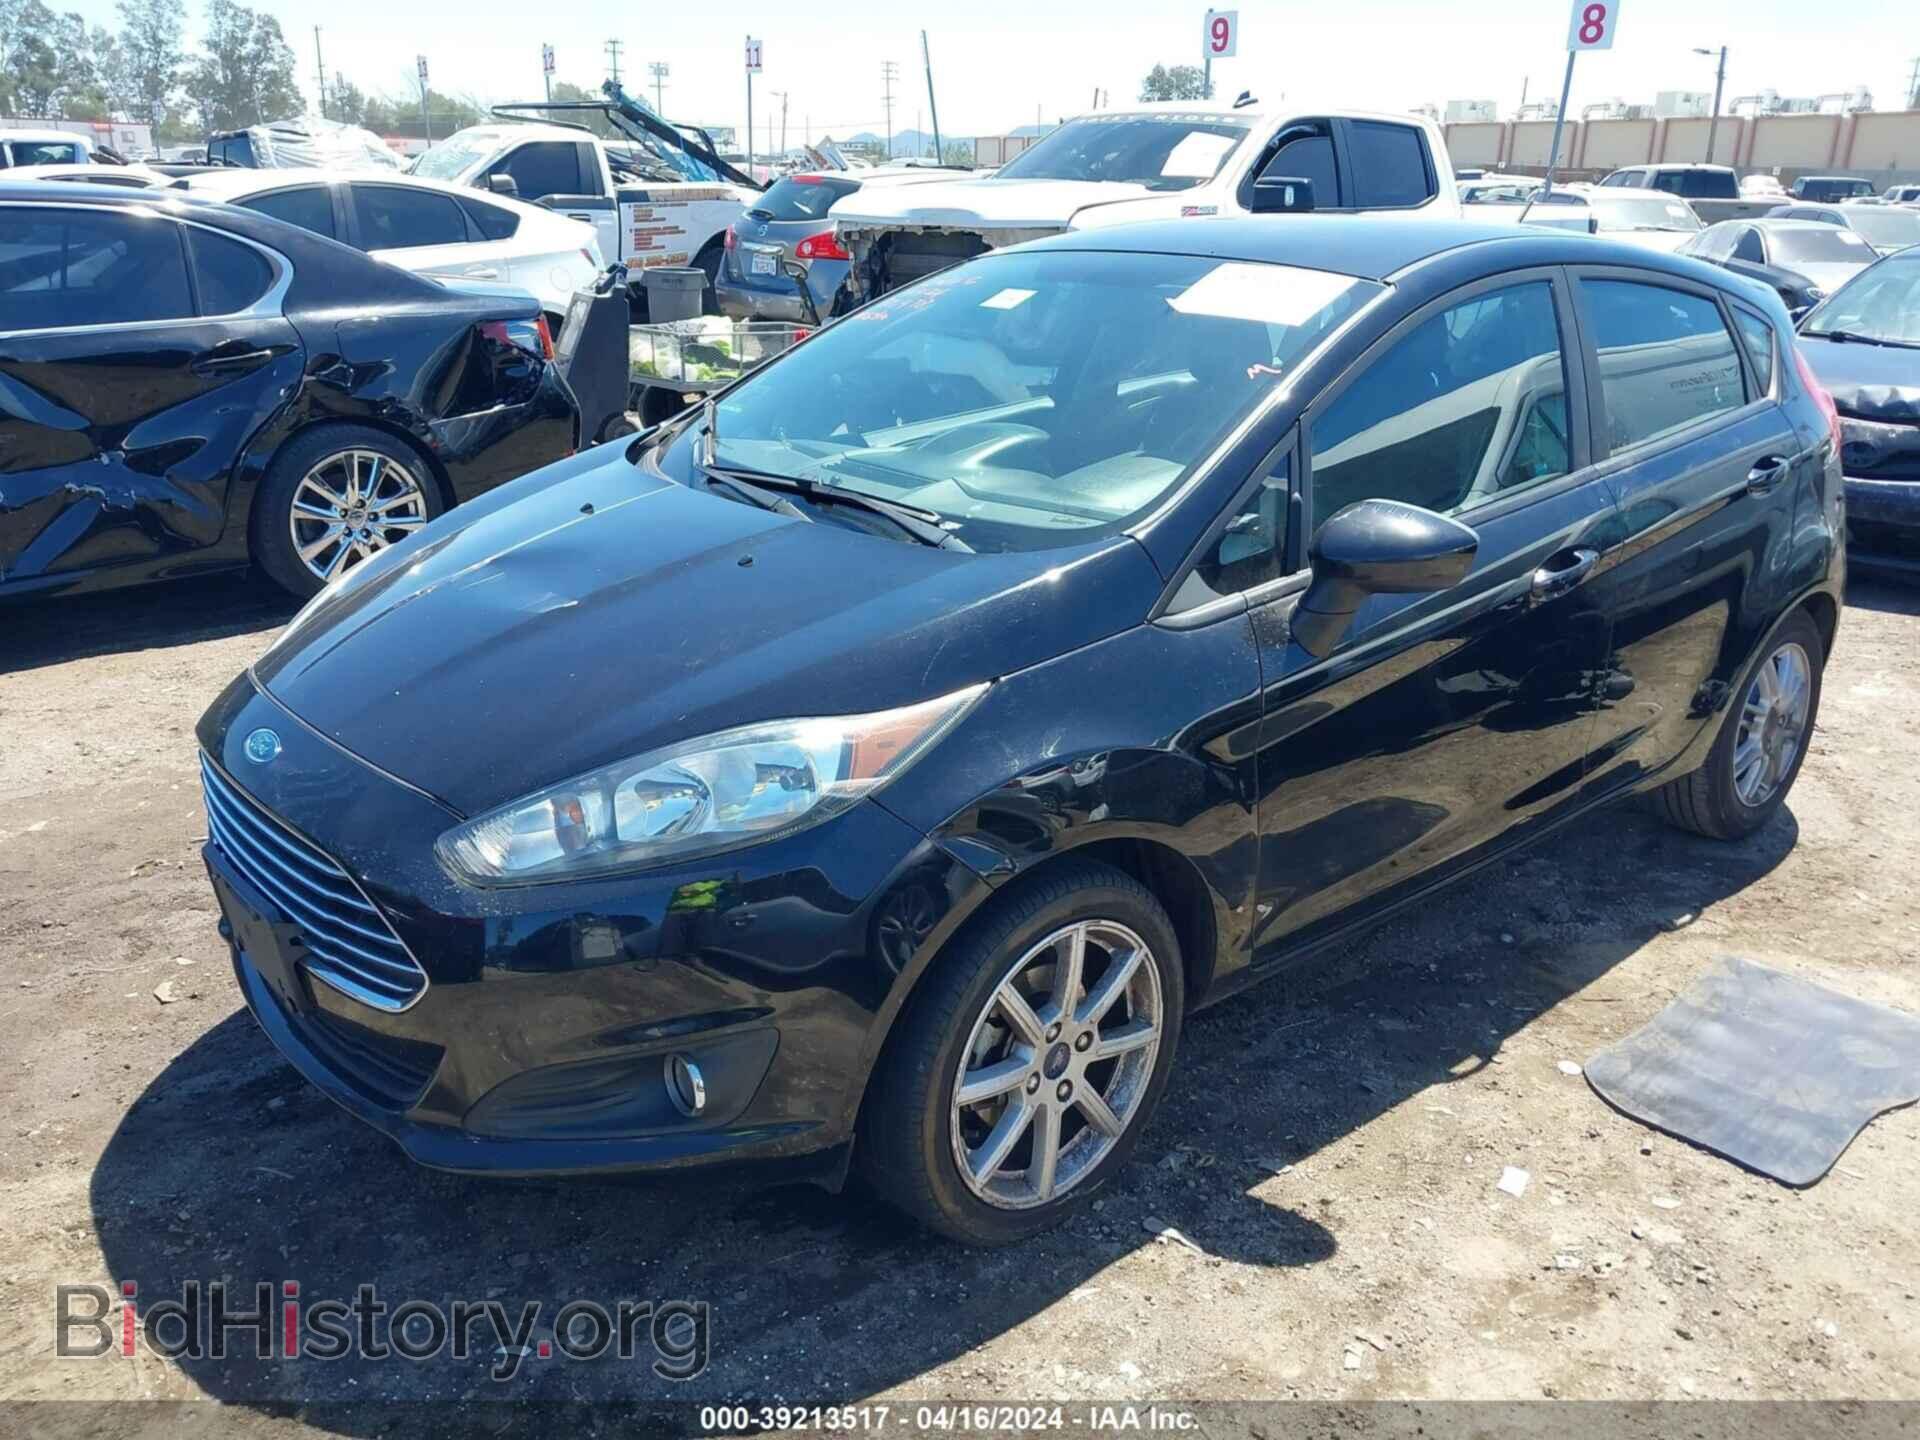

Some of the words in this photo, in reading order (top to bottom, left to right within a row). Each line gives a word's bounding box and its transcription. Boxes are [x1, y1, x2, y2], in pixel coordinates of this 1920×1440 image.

[1211, 17, 1229, 52] 9
[1579, 3, 1606, 44] 8
[745, 46, 762, 68] 11
